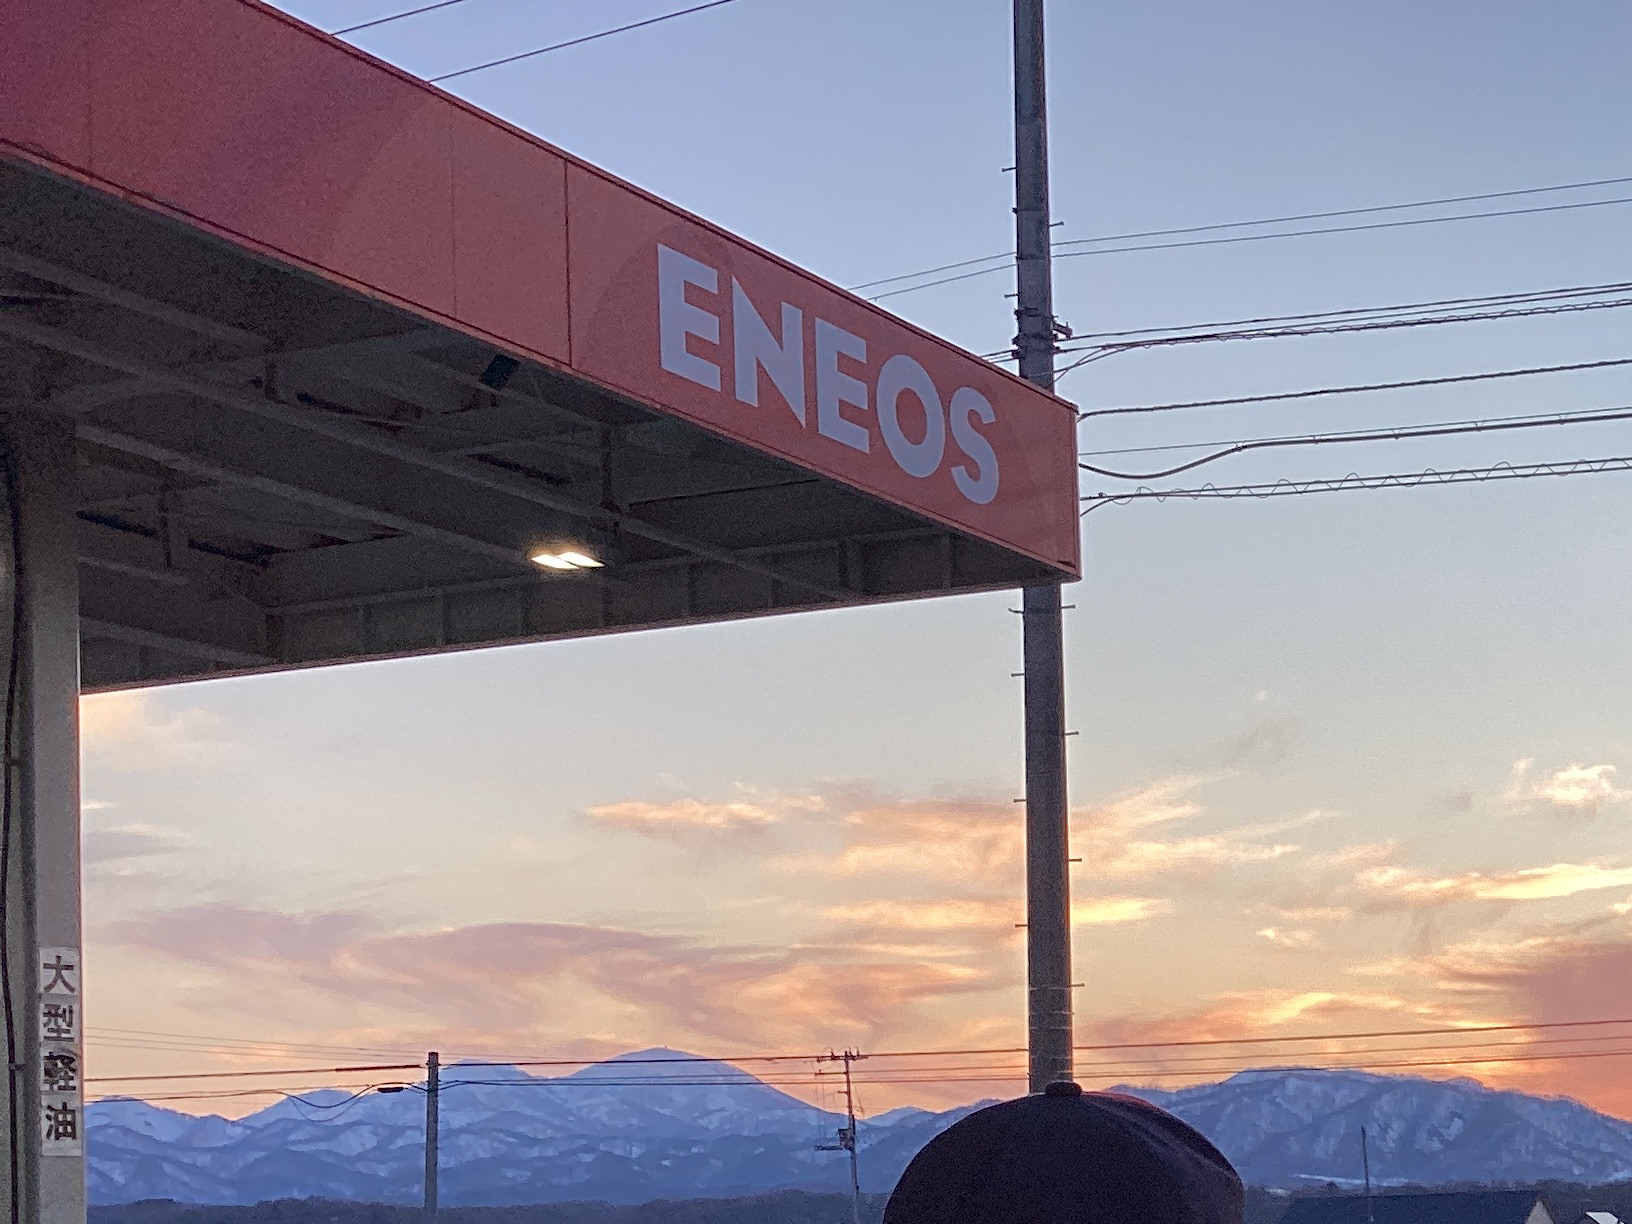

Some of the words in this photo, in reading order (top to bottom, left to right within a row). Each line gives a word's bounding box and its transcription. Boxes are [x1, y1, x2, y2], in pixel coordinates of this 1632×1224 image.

[657, 243, 1000, 505] ENEOS
[43, 955, 77, 1141] 大型軽油
